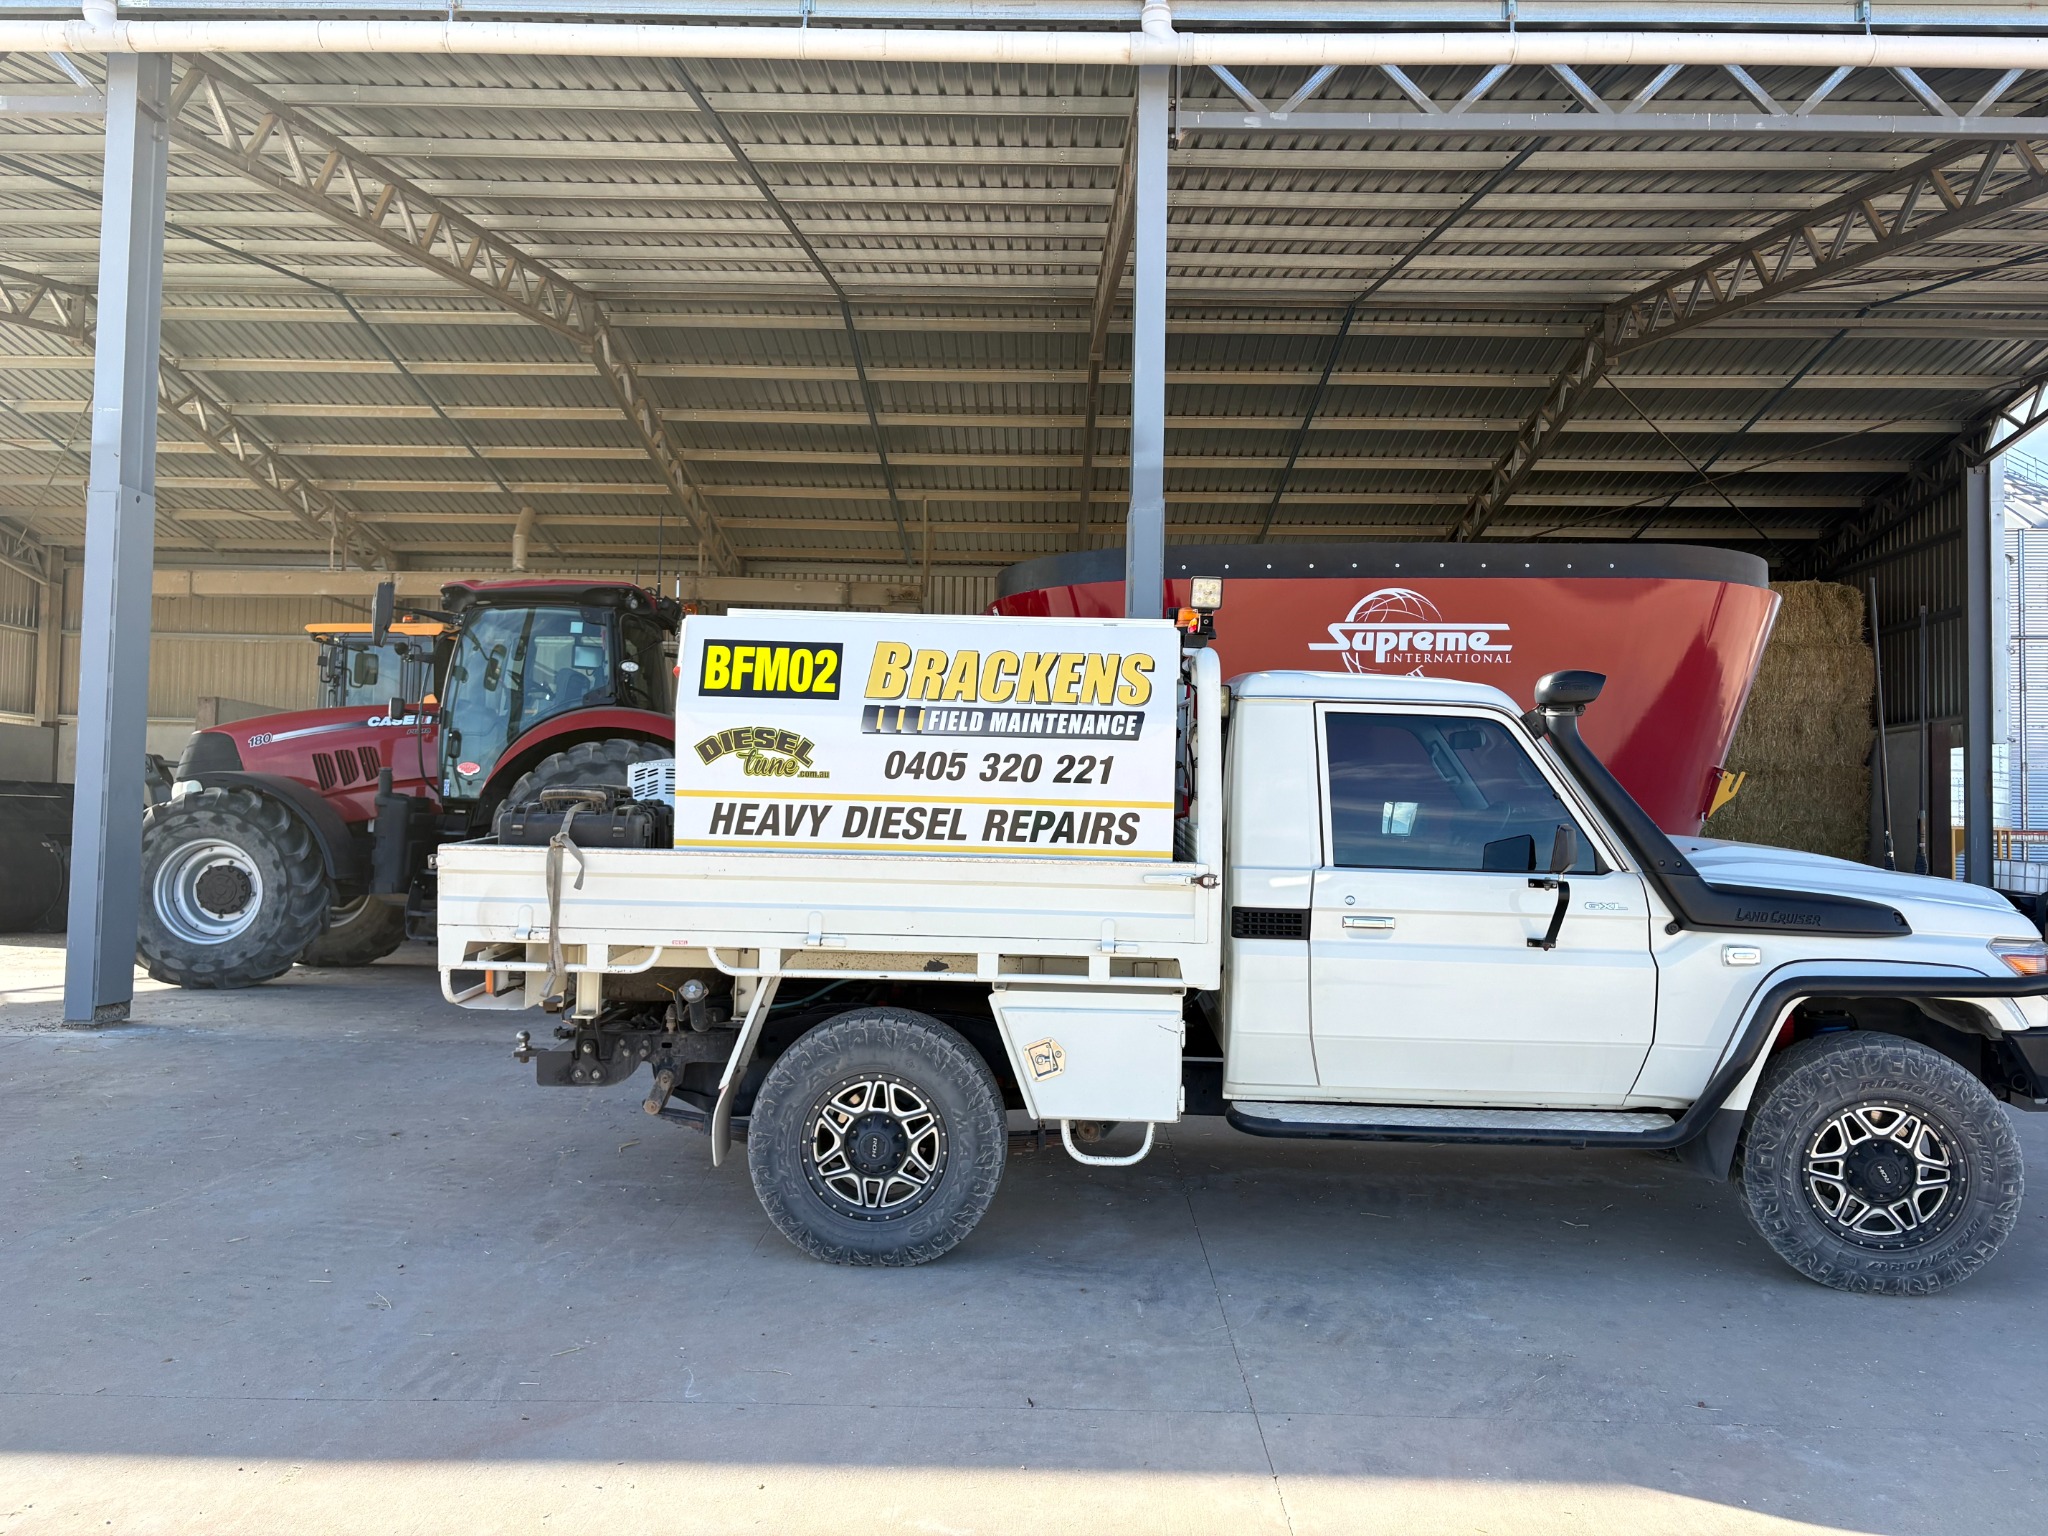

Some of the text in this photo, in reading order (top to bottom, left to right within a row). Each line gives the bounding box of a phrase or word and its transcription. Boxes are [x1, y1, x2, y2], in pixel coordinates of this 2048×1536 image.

[1308, 622, 1513, 663] Supreme
[703, 645, 838, 693] BFM02
[1386, 653, 1512, 663] INTERNATIONAL
[864, 641, 1155, 706] BRACKENS
[928, 710, 1139, 736] FIELD MAINTENANCE
[248, 732, 273, 747] 180
[694, 726, 815, 768] DIESEL
[797, 770, 830, 778] .com.au
[884, 751, 1115, 785] 0405 320 221
[709, 803, 1141, 845] HEAVY DIESEL REPAIRS
[1584, 901, 1628, 910] GXL
[1735, 907, 1822, 926] LAND CRUISER
